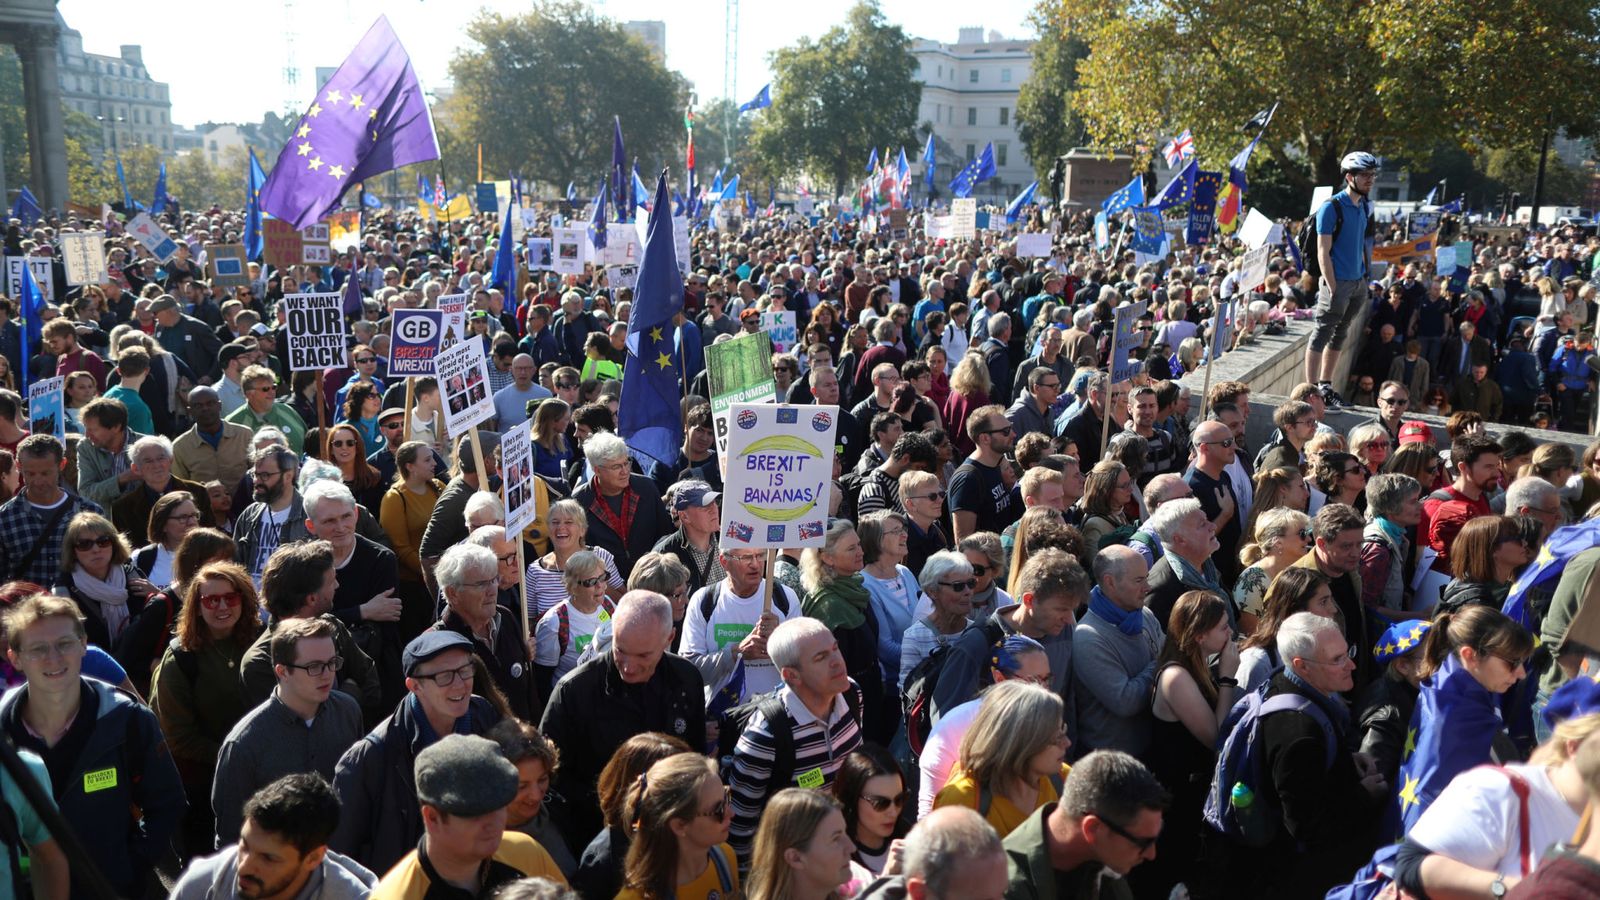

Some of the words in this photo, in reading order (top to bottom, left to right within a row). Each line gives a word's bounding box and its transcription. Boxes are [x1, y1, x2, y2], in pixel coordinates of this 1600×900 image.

[286, 297, 305, 309] WE
[306, 296, 340, 308] WANT
[288, 308, 342, 336] OUR
[403, 320, 430, 338] GB
[290, 335, 343, 349] COUNTRY
[291, 347, 344, 368] BACK
[395, 345, 434, 359] BREXIT
[437, 352, 454, 367] Who's
[455, 345, 470, 357] most
[394, 359, 433, 372] WREXIT
[439, 359, 456, 374] afraid
[457, 355, 465, 364] of
[440, 364, 464, 381] People's
[714, 384, 772, 410] ENVIRONMENT
[746, 455, 810, 472] BREXIT
[769, 473, 784, 487] IS
